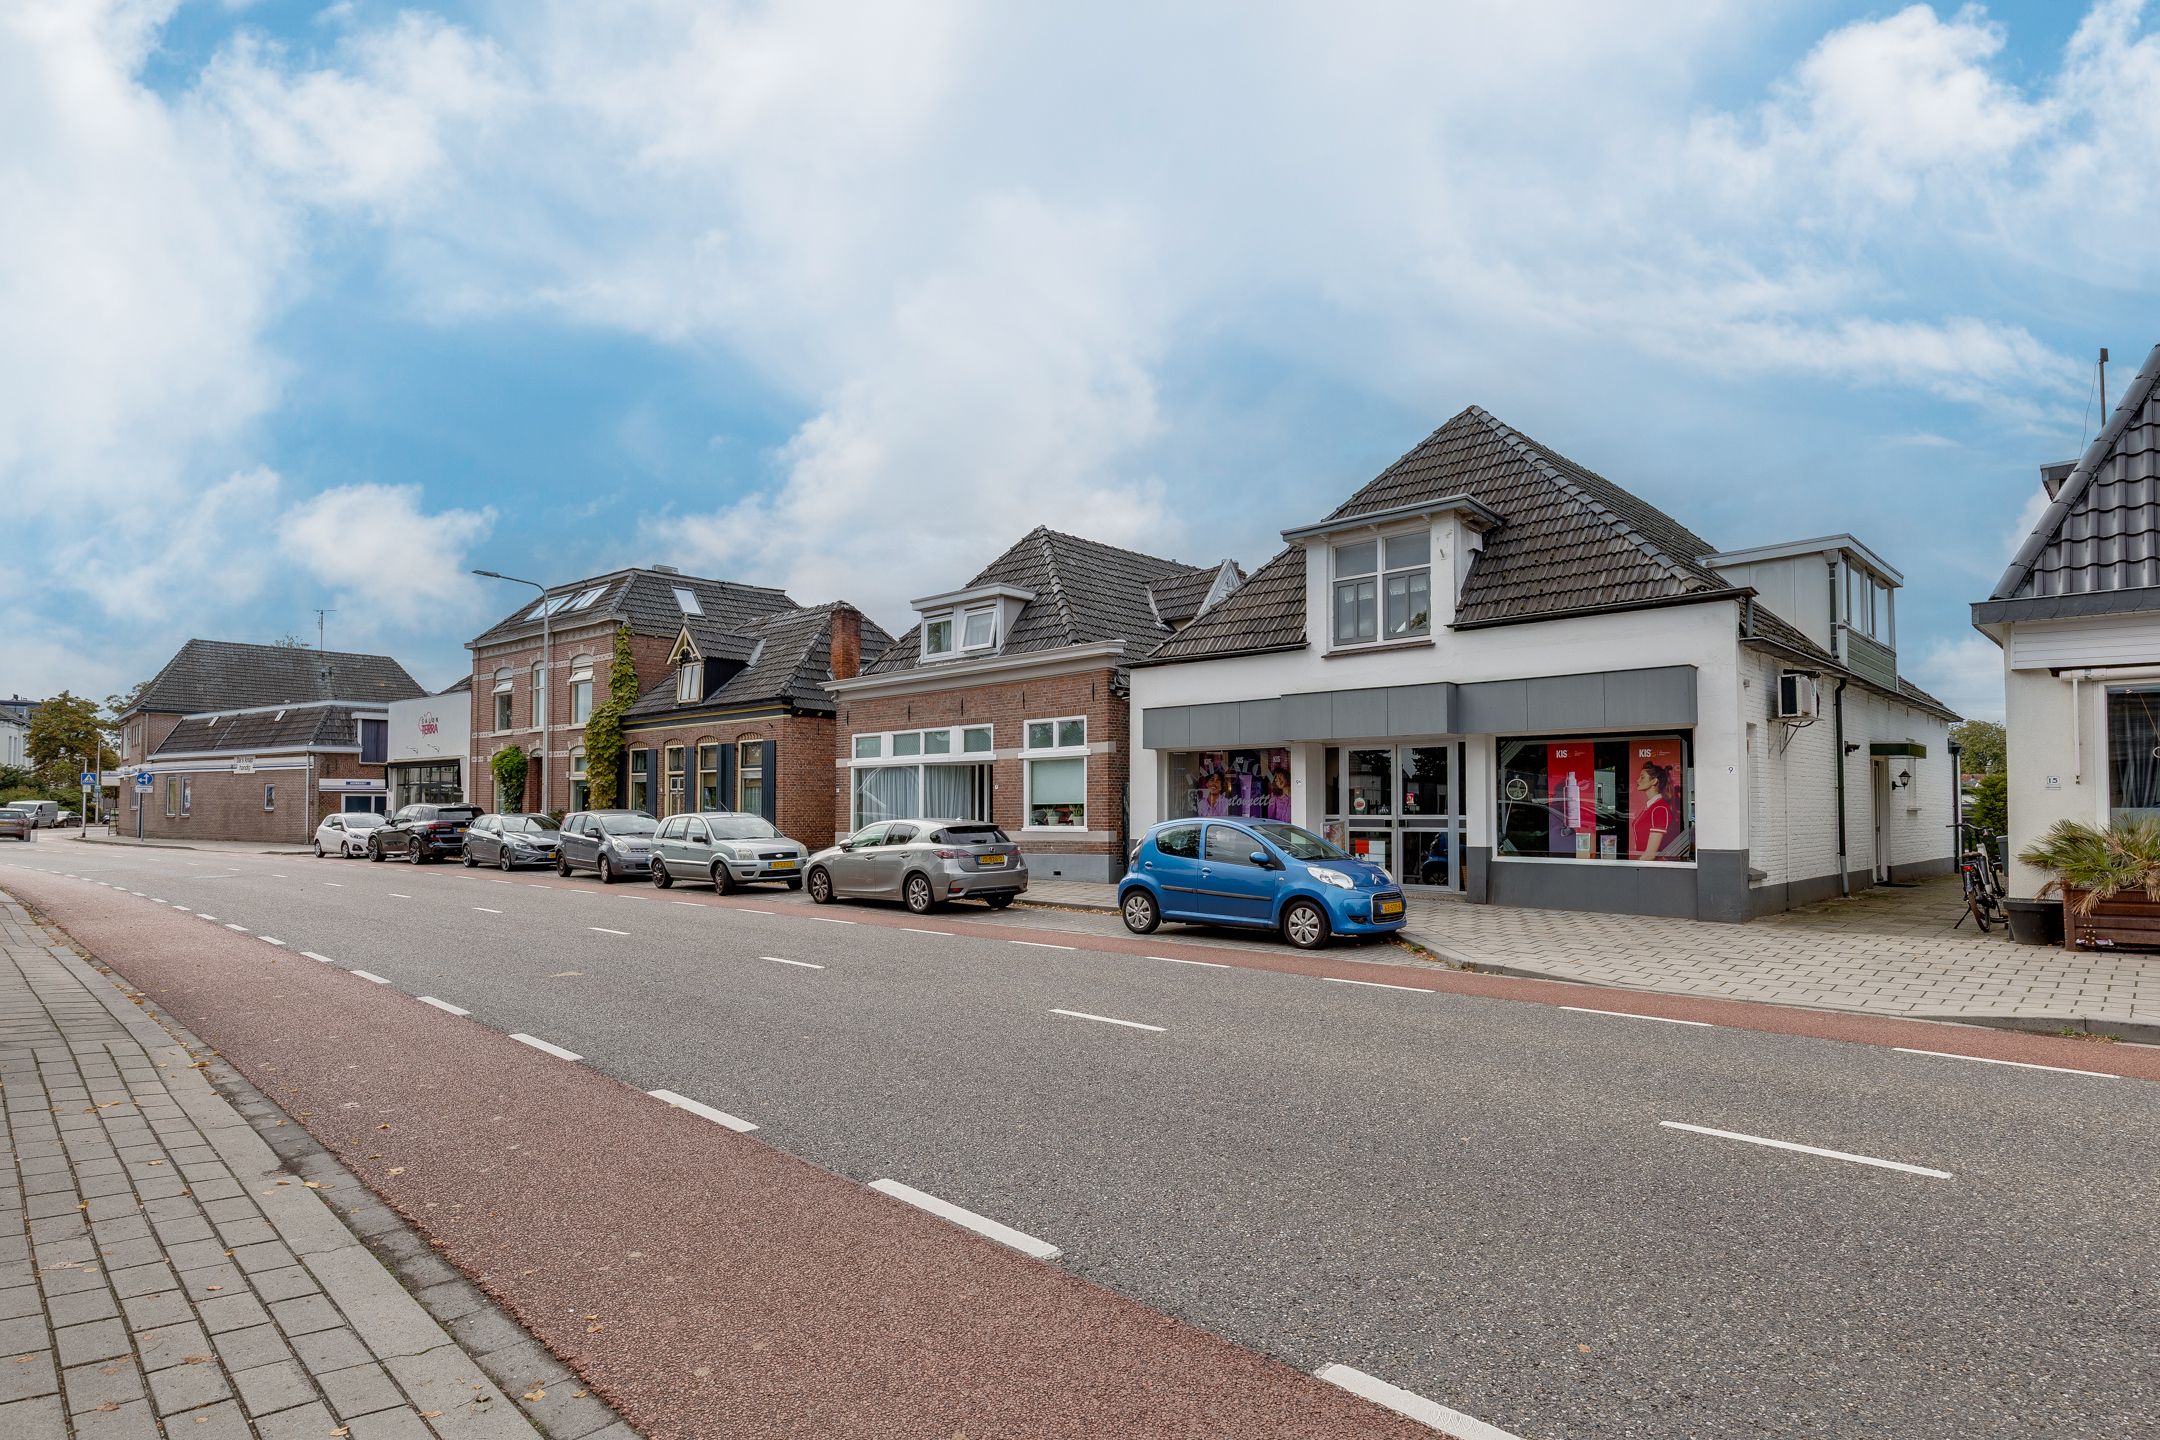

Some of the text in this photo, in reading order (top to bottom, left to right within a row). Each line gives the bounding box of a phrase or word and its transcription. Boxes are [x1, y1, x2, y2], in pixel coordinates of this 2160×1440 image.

[421, 723, 439, 734] TERRA
[1556, 750, 1568, 759] KIS
[1639, 749, 1652, 758] KIS
